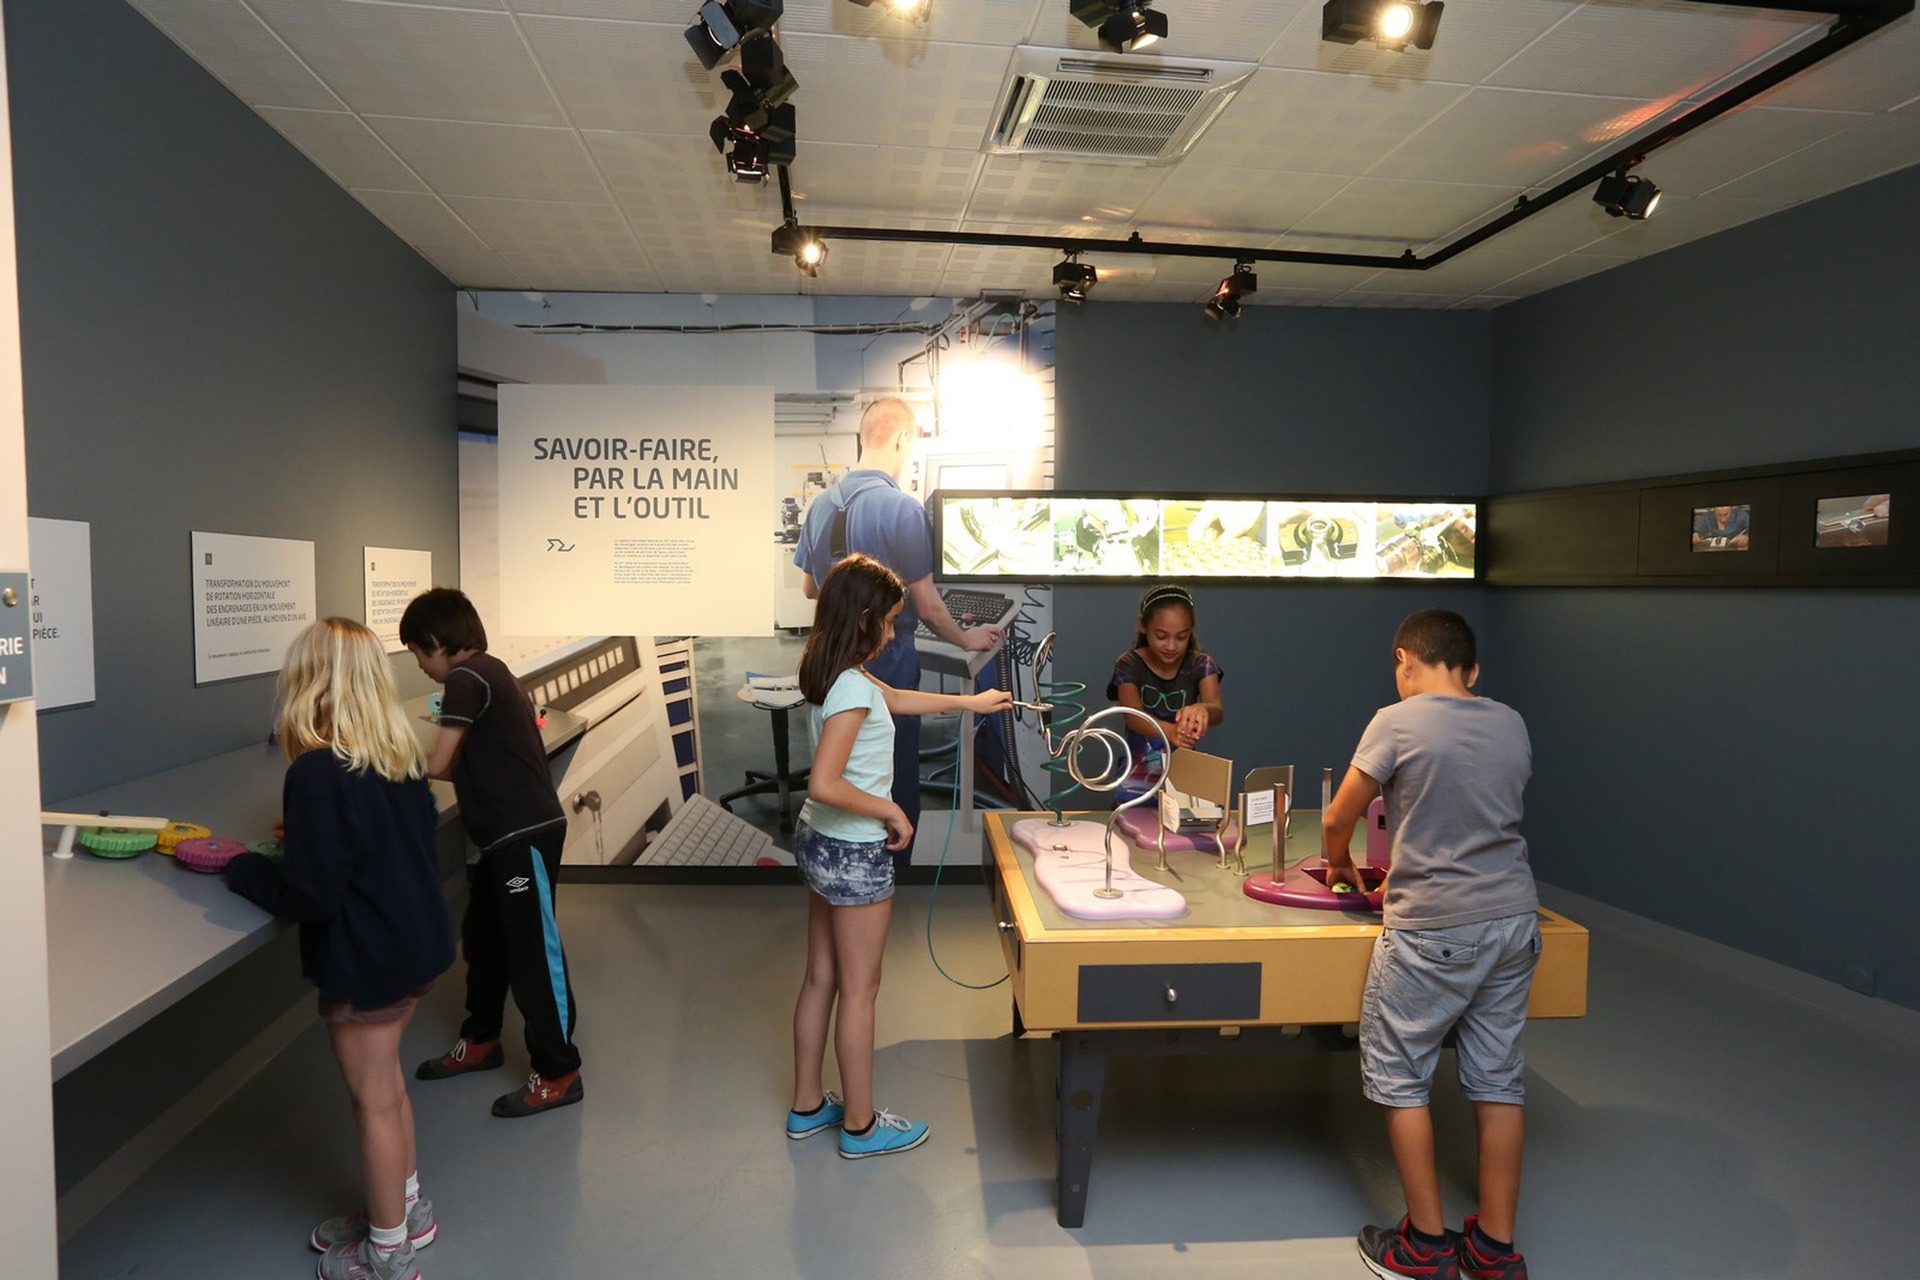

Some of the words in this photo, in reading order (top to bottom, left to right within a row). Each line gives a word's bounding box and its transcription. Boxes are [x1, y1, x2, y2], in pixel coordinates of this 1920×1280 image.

[533, 437, 718, 463] SAVOIR-FAIRE,
[574, 467, 624, 490] PAR
[633, 467, 664, 490] LA
[672, 467, 739, 490] MAIN
[574, 496, 605, 519] ET
[613, 496, 710, 519] L'OUTIL
[206, 580, 253, 588] TRANSFORMATION
[254, 580, 261, 588] DU
[262, 580, 291, 588] MOUVEMENT
[206, 593, 214, 601] DE
[214, 592, 241, 601] ROTATION
[242, 592, 275, 600] HORIZONTALE
[206, 605, 217, 614] DES
[218, 604, 252, 613] ENGRENAGES
[253, 604, 260, 612] EN
[269, 603, 296, 611] MOUVEMENT
